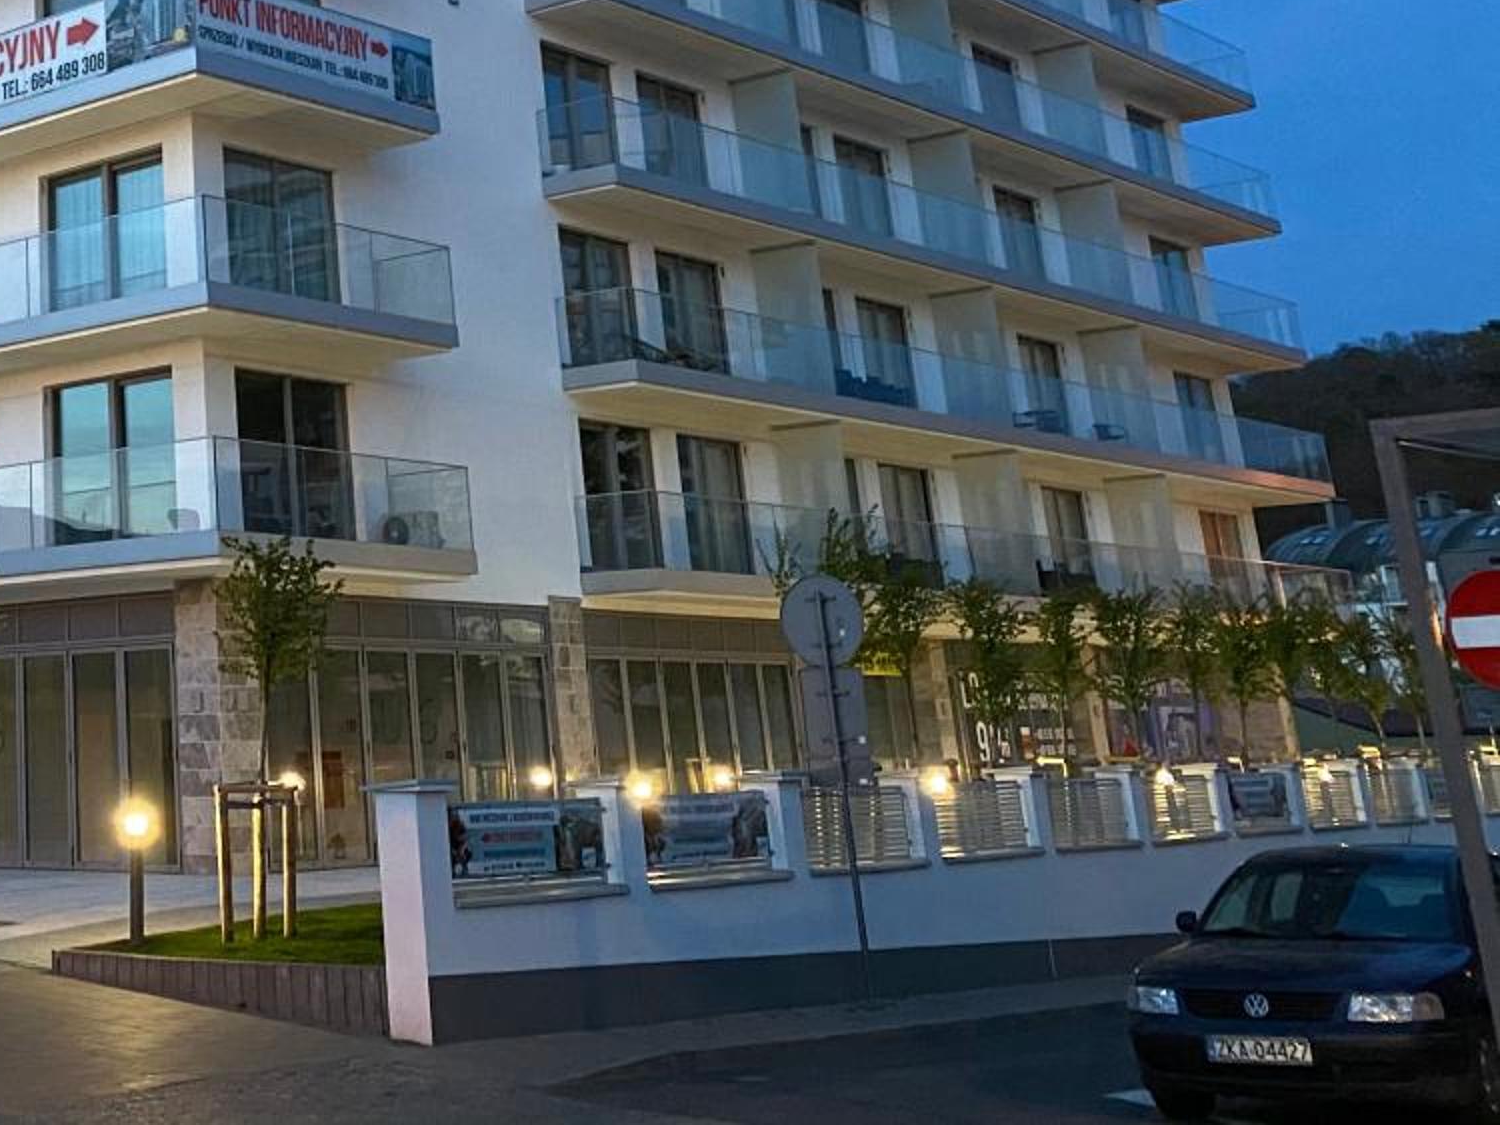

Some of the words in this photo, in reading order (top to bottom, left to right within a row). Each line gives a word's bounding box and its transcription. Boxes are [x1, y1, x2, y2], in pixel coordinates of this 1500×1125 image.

[255, 0, 369, 62] INFORMACYJNY
[31, 69, 54, 94] 664
[56, 59, 79, 82] 489
[81, 51, 106, 75] 308
[1217, 1038, 1250, 1060] ZKA
